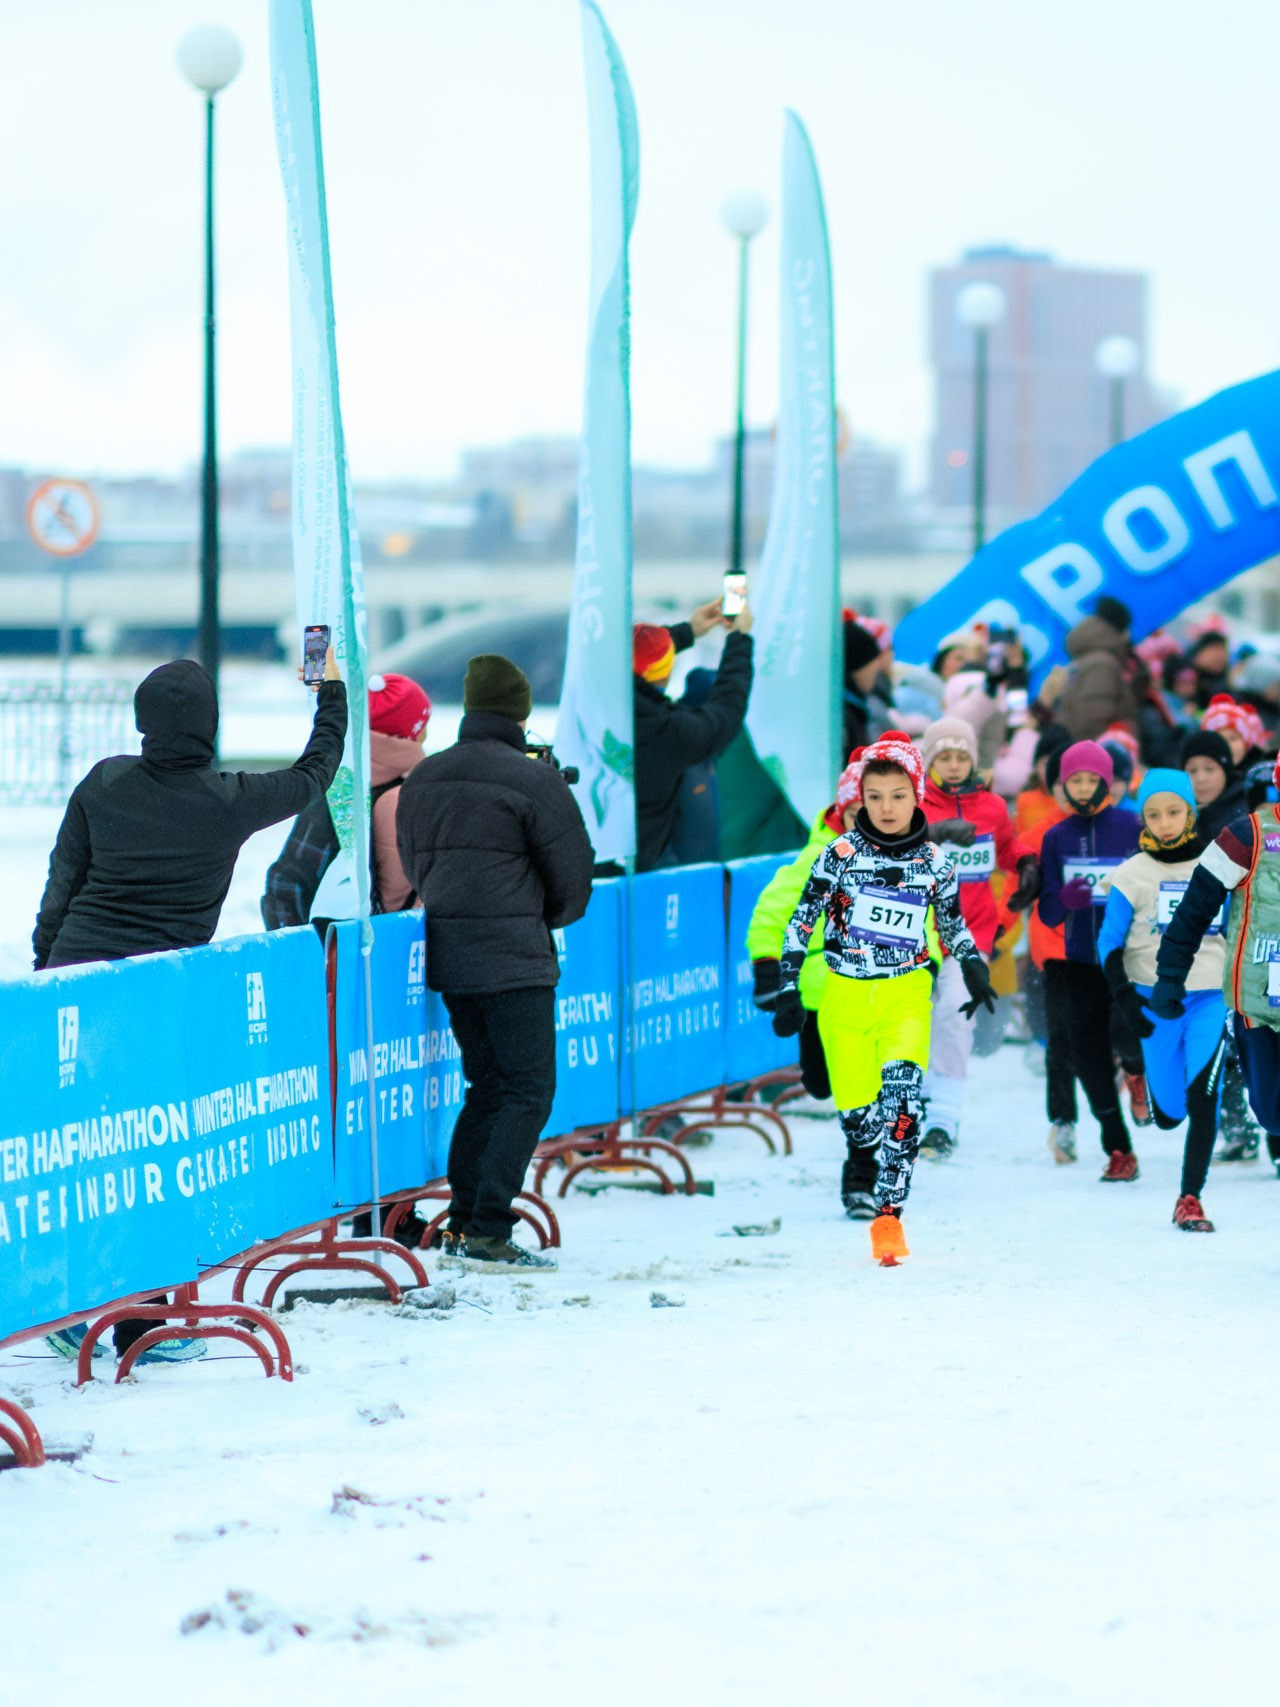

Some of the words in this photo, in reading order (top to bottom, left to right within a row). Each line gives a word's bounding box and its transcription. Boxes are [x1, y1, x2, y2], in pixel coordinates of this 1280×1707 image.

[936, 737, 968, 749] FILA
[950, 849, 990, 866] 5098
[869, 905, 914, 929] 5171
[348, 1043, 389, 1087] WINER
[236, 1064, 319, 1121] HAFMARATHON
[33, 1100, 190, 1174] HAFMARATHON
[198, 1114, 321, 1193] EKATEINBURG
